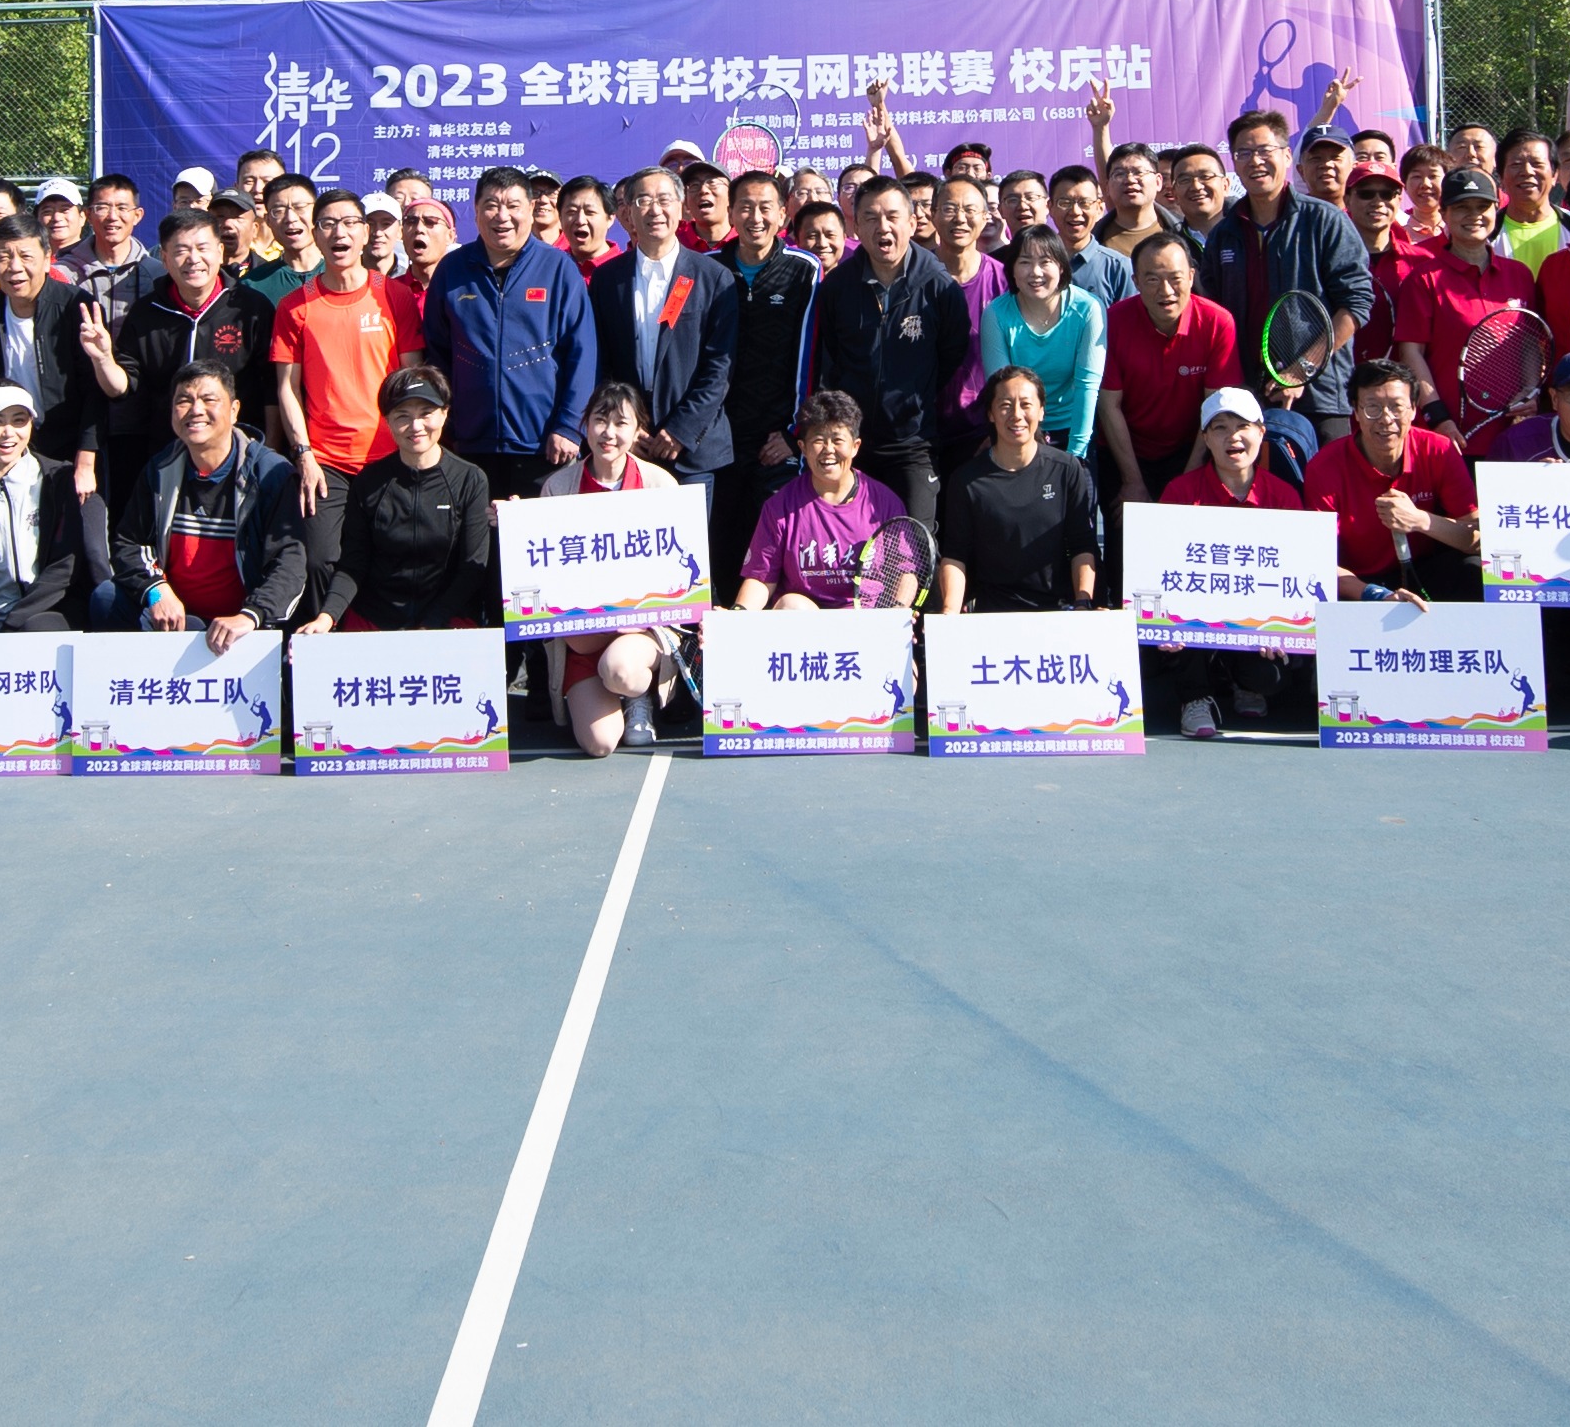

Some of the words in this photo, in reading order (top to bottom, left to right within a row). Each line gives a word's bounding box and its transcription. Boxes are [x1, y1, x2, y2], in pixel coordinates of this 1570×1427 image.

[370, 63, 508, 108] 2023
[520, 48, 995, 106] 全球清华校友网球联赛
[1009, 44, 1152, 93] 校庆站
[427, 143, 525, 159] 清华大学体育部
[526, 526, 684, 568] 计算机战队
[1186, 542, 1279, 567] 经管学院
[1161, 570, 1303, 598] 校友网球一队
[1499, 589, 1533, 601] 2023
[518, 621, 552, 636] 2023
[553, 612, 658, 633] 全球清华校友网球联赛
[660, 608, 692, 622] 校庆站
[1138, 628, 1170, 640] 2023
[1172, 632, 1281, 648] 全球清华校友网球联赛
[1284, 638, 1316, 649] 校庆站
[768, 651, 862, 682] 机械系
[970, 653, 1099, 685] 土木战队
[1348, 648, 1510, 676] 工物物理系队
[108, 676, 249, 705] 清华教工队
[333, 674, 463, 707] 材料学院
[718, 737, 750, 750] 2023
[752, 736, 859, 750] 全球清华校友网球联赛
[861, 734, 894, 748] 校庆站
[945, 741, 978, 754] 2023
[980, 740, 1088, 754] 全球清华校友网球联赛
[1091, 738, 1125, 752] 校庆站
[1336, 731, 1370, 745] 2023
[1371, 732, 1488, 748] 全球清华校友网球联赛
[1490, 733, 1526, 748] 校庆站
[29, 760, 61, 773] 校庆站
[86, 760, 118, 773] 2023
[119, 760, 226, 773] 全球清华校友网球联赛
[227, 759, 261, 772] 校庆站
[310, 759, 343, 772] 2023
[345, 757, 453, 771] 全球清华校友网球联赛
[455, 756, 489, 769] 校庆站
